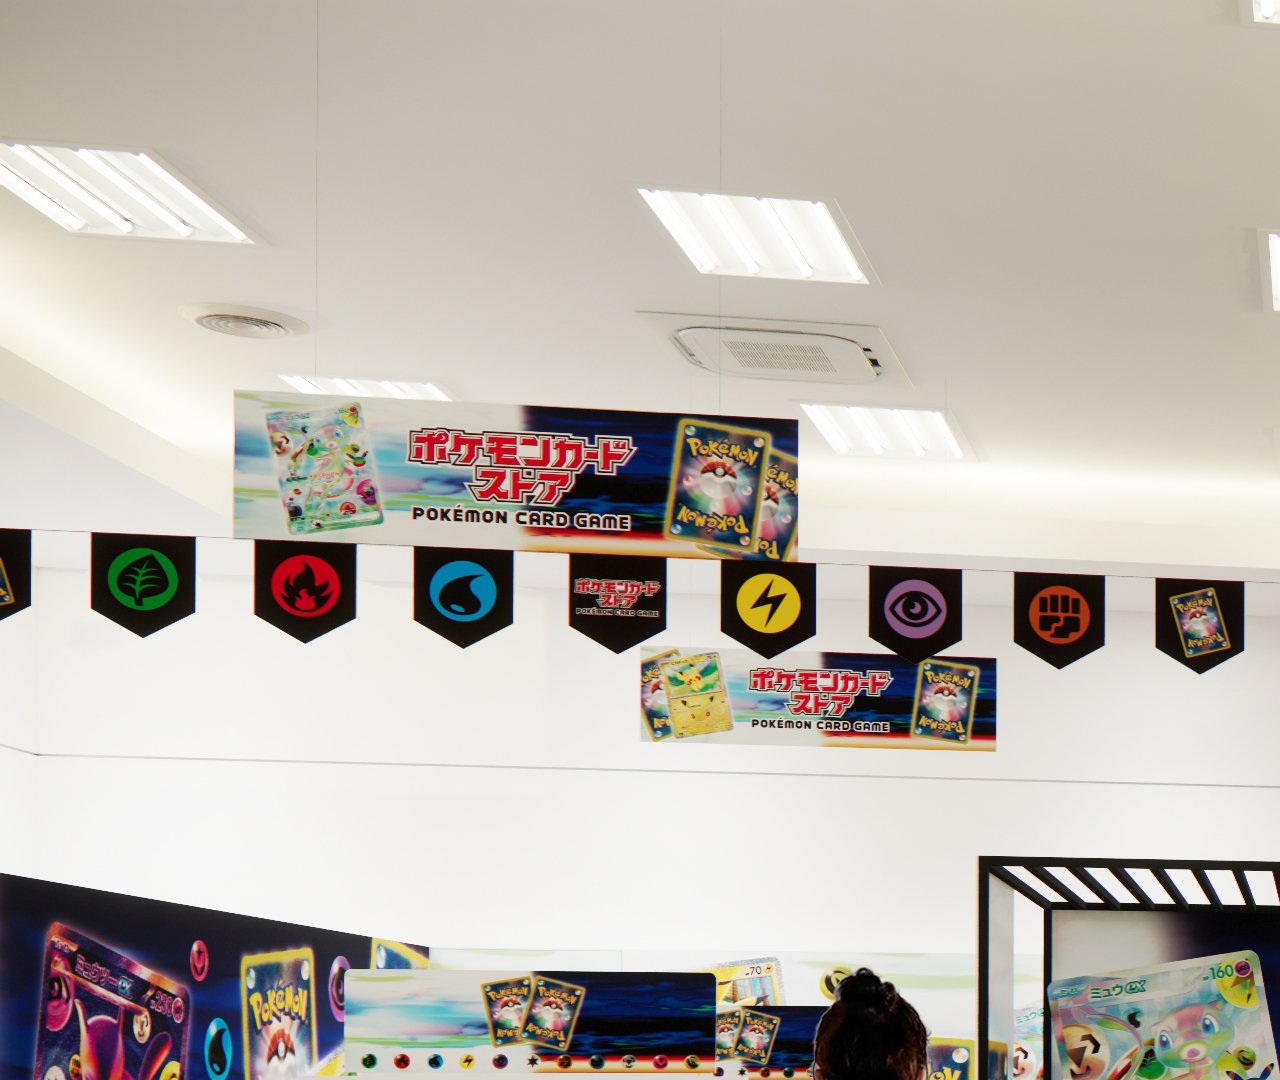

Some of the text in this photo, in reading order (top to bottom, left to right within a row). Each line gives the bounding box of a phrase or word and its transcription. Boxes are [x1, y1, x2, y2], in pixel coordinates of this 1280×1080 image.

[409, 429, 634, 473] ポケモンカード
[471, 467, 574, 505] ストア
[412, 504, 631, 531] POKÉMON CARD GAME
[574, 579, 659, 595] ポケモンカード
[598, 594, 637, 607] ストア
[750, 670, 888, 696] ポケモンカード
[788, 694, 852, 716] ストア
[752, 718, 889, 733] POKÉMON CARD GAME
[1210, 963, 1234, 980] 160
